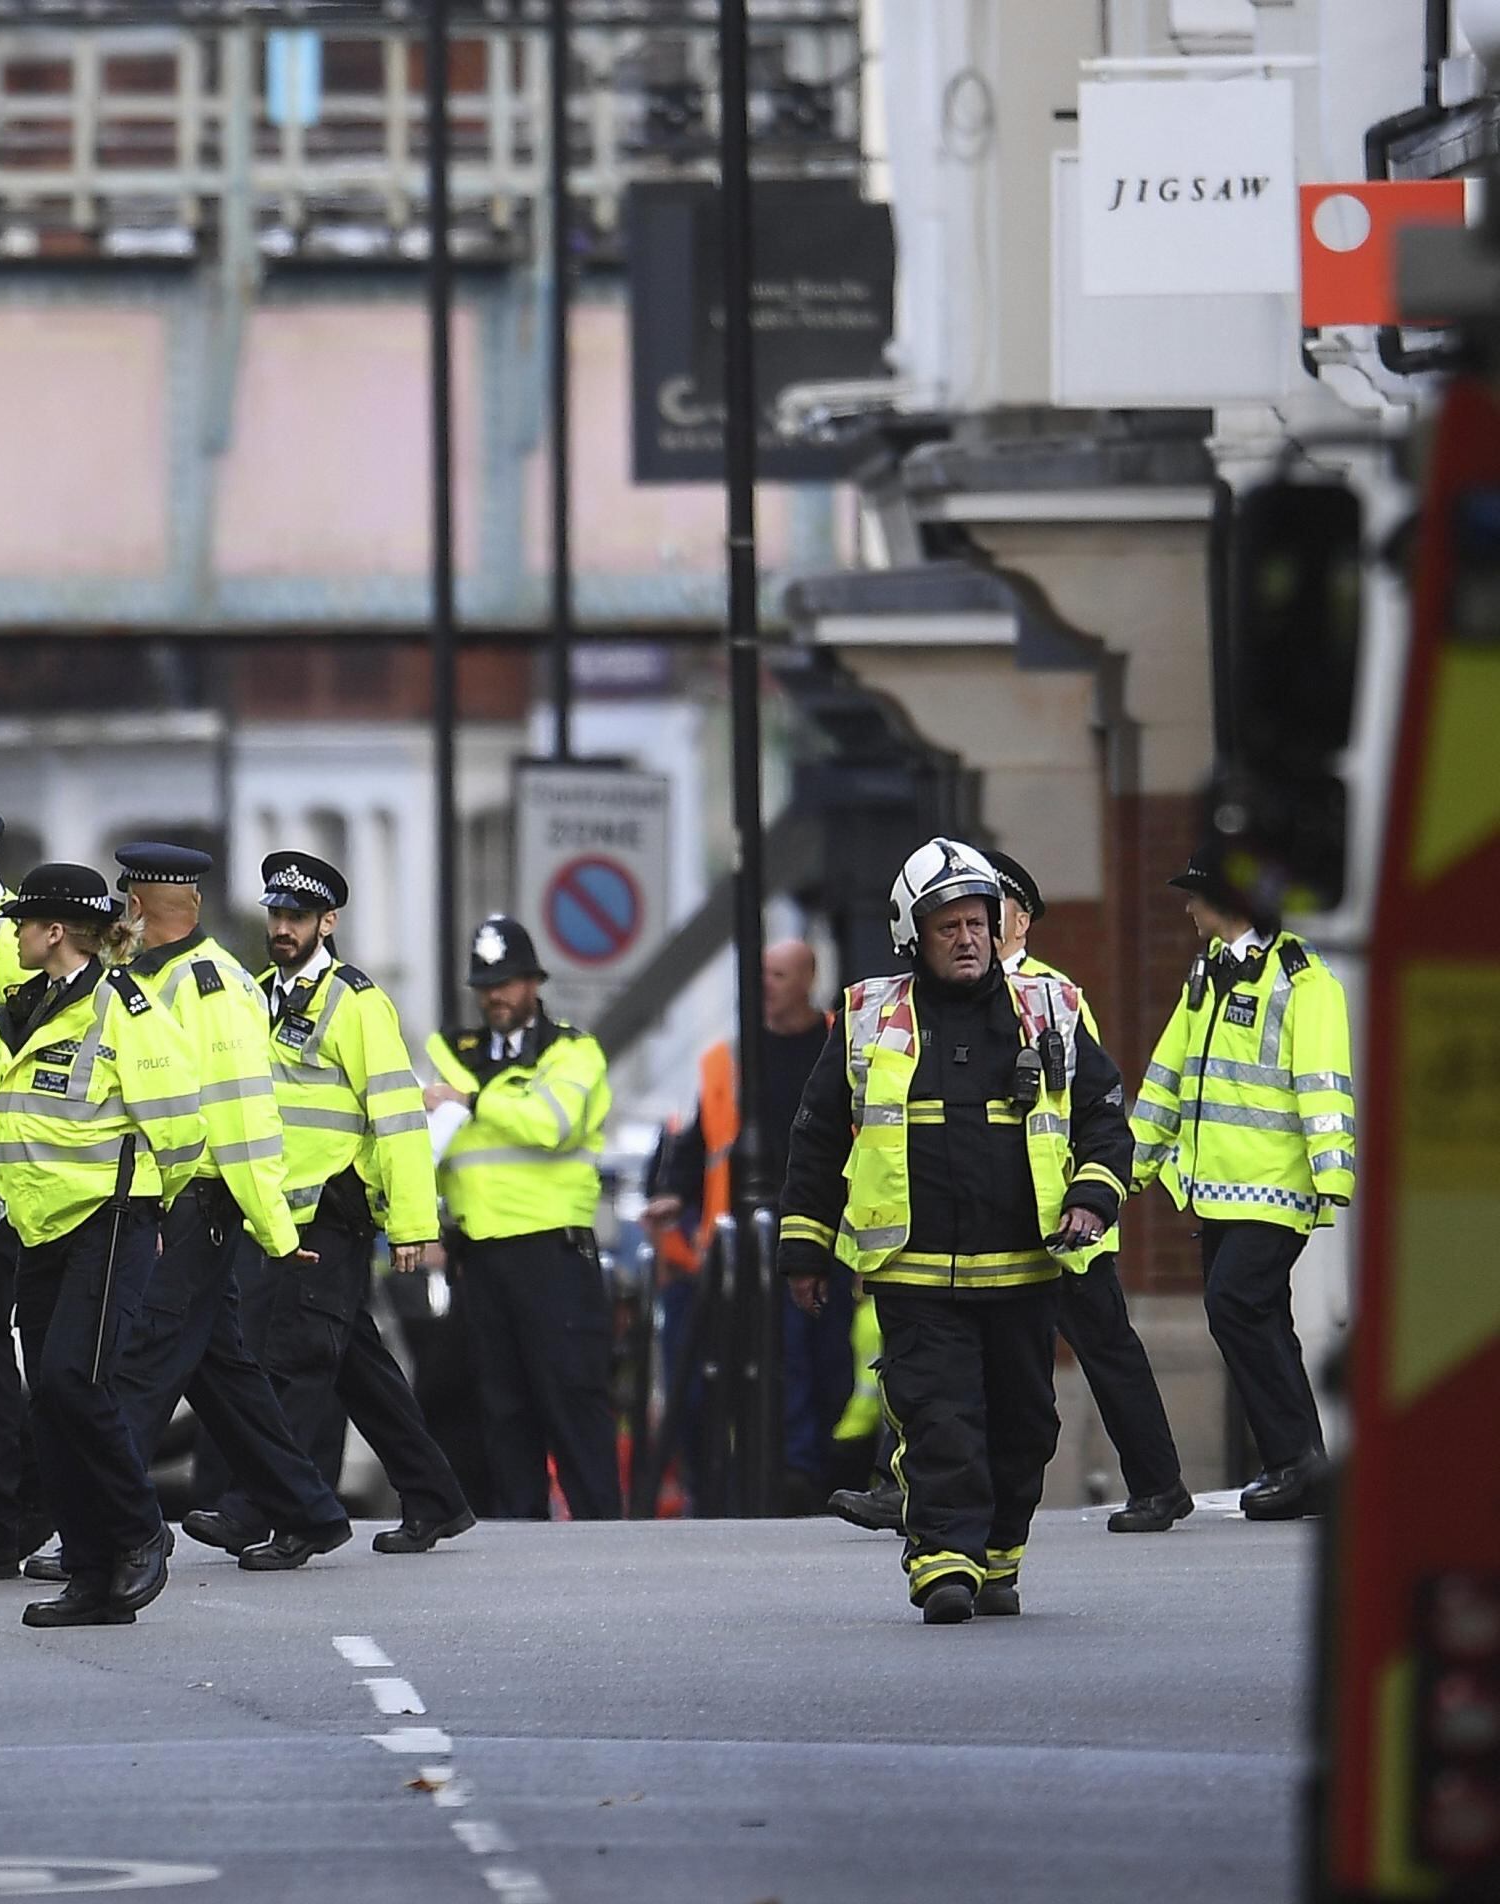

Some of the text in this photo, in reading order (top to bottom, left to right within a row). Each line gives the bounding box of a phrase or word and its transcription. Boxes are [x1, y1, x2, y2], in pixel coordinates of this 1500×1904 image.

[1108, 176, 1271, 211] JIGSAW
[212, 1039, 244, 1053] POLICE
[136, 1056, 171, 1071] POLICE
